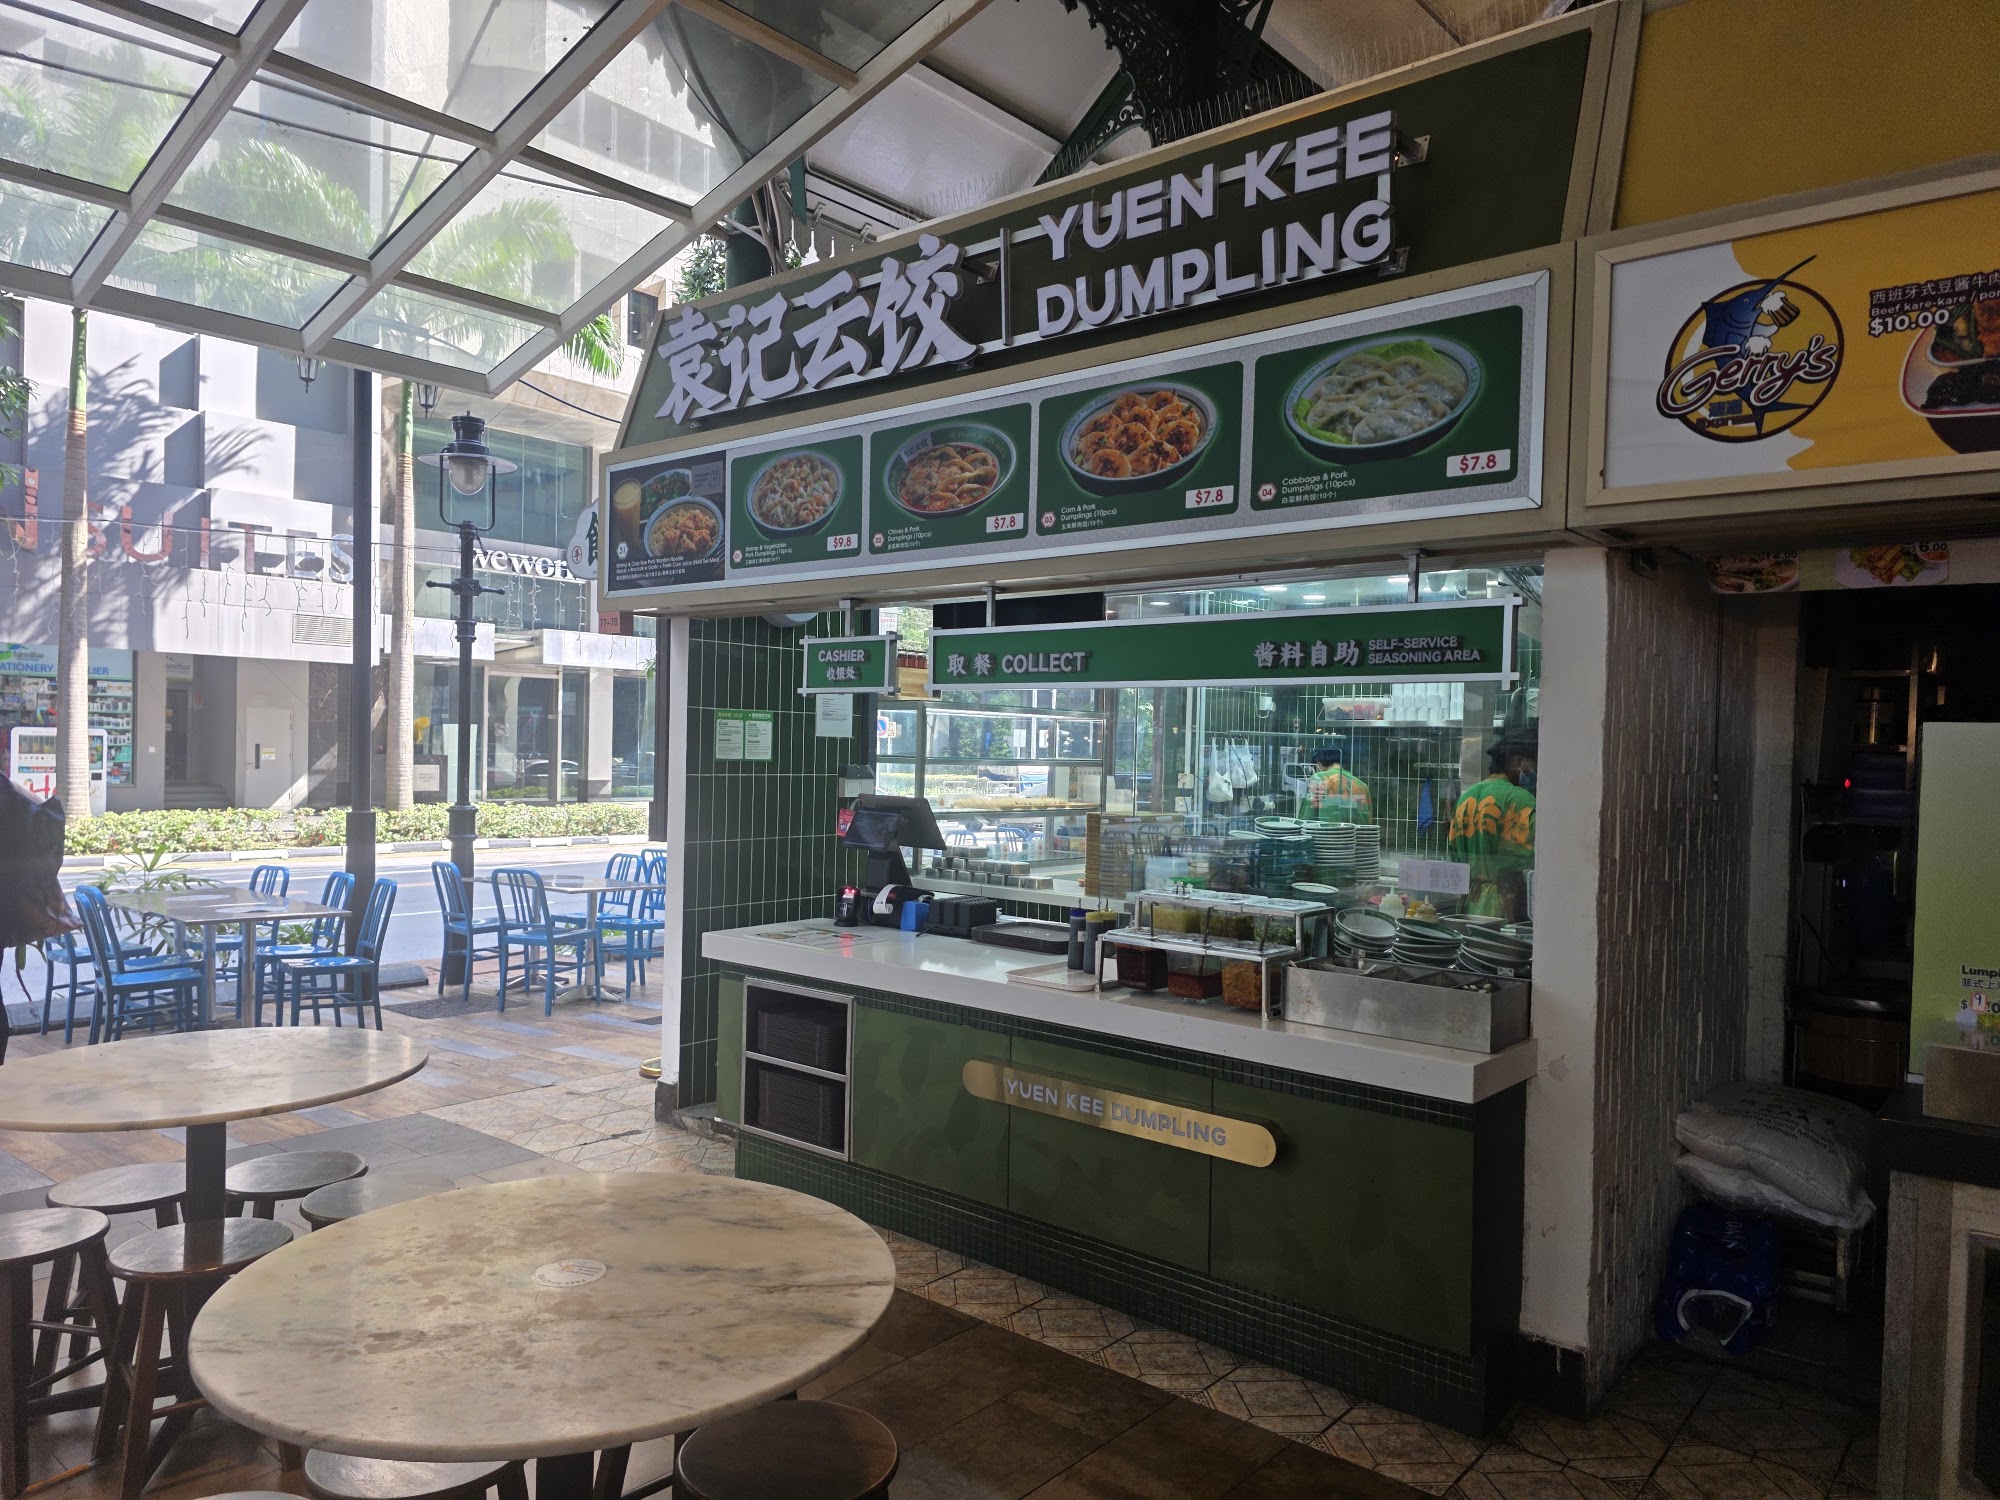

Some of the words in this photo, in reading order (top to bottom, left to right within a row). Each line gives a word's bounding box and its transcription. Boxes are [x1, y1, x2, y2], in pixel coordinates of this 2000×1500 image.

[1038, 162, 1219, 261] YUEN
[1244, 110, 1396, 209] KEE
[1036, 199, 1396, 339] DUMPLING
[1871, 303, 1900, 316] Beef
[1904, 295, 1967, 311] kare-kare
[1979, 290, 2000, 304] por
[655, 233, 981, 424] 袁记云饺
[1870, 308, 1950, 336] $10.00
[1657, 335, 1838, 419] Gerry's
[1459, 453, 1498, 474] $7.8
[1262, 488, 1273, 497] 04
[1282, 475, 1321, 486] Cabbage
[1330, 471, 1348, 479] Pork
[1282, 482, 1323, 494] Dumplings
[1325, 478, 1356, 489] (10pcs)
[1195, 488, 1224, 506] $7.8
[1060, 511, 1093, 521] Dumplings
[1093, 508, 1117, 518] (10pcs)
[1061, 506, 1076, 514] Corn
[1082, 503, 1097, 511] Pork
[993, 515, 1016, 531] $7.8
[833, 535, 852, 550] $9.8
[887, 533, 912, 542] Dumplings
[618, 546, 627, 555] 31
[473, 547, 577, 580] wewor
[600, 617, 618, 628] 77-78
[1368, 635, 1458, 650] SELF-SERVICE
[818, 649, 866, 662] CASHIER
[947, 653, 993, 677] 取餐
[1002, 652, 1087, 674] COLLECT
[1368, 651, 1441, 665] SEASONING
[1443, 648, 1481, 663] AREA
[1005, 1078, 1058, 1106] YUEN
[1065, 1092, 1104, 1117] KEE
[1111, 1103, 1227, 1147] DUMPLING
